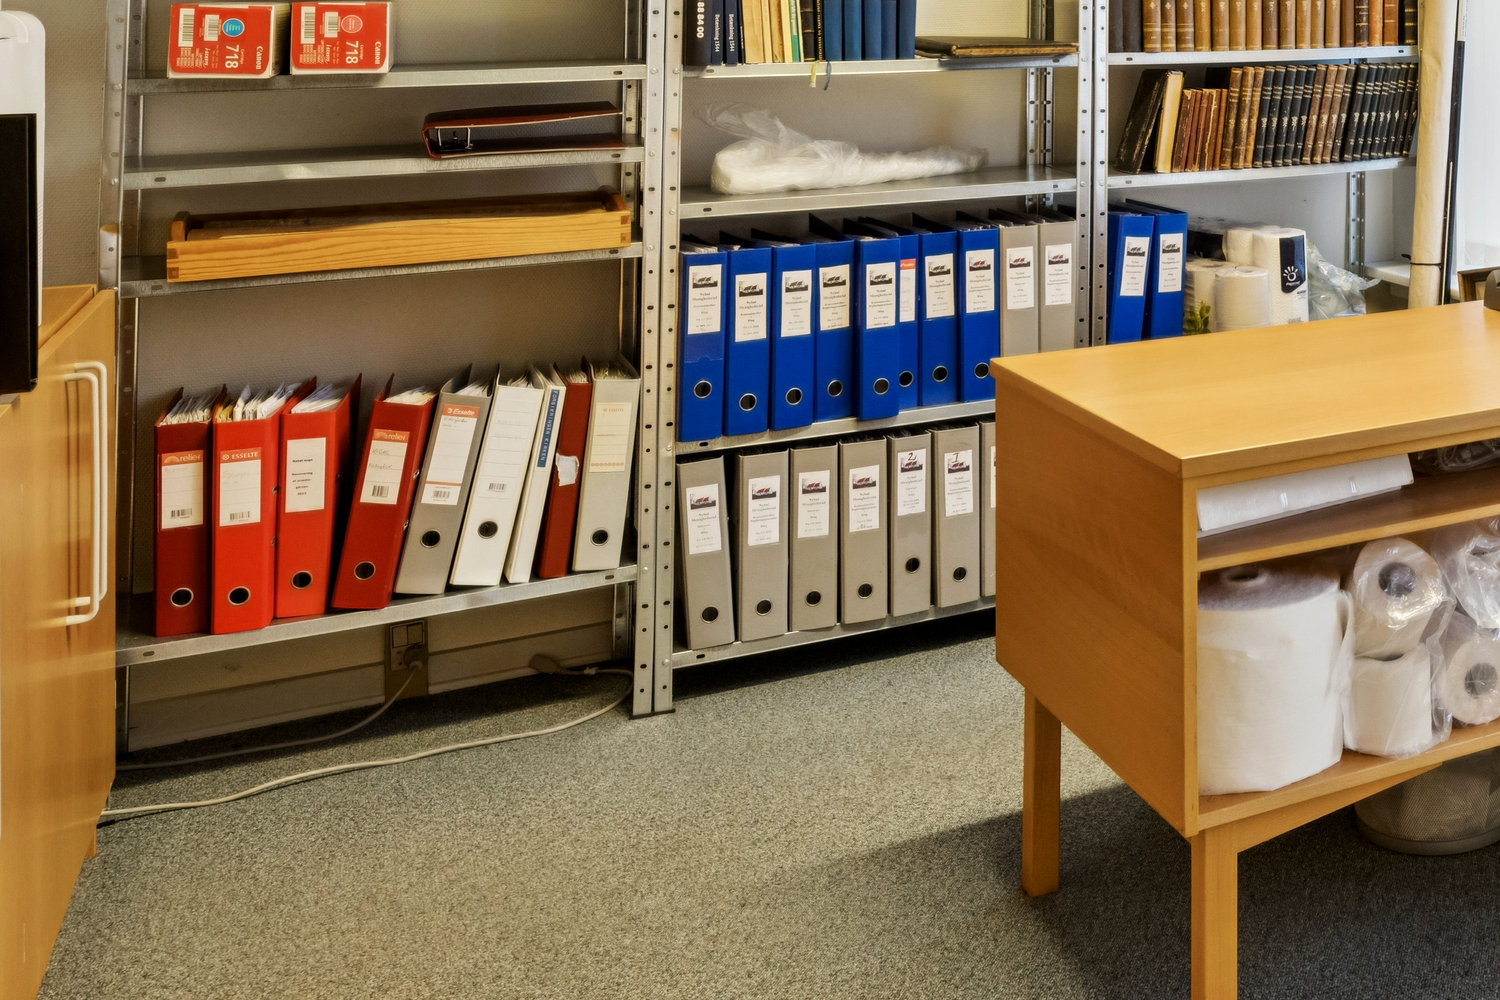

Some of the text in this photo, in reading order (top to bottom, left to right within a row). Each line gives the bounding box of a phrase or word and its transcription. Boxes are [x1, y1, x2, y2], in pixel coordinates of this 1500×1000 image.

[697, 1, 705, 13] 88
[697, 13, 705, 25] 84
[696, 26, 704, 38] 00
[225, 44, 240, 68] 718
[256, 46, 264, 70] Canon
[345, 41, 359, 64] 718
[231, 451, 258, 460] ESSELTE
